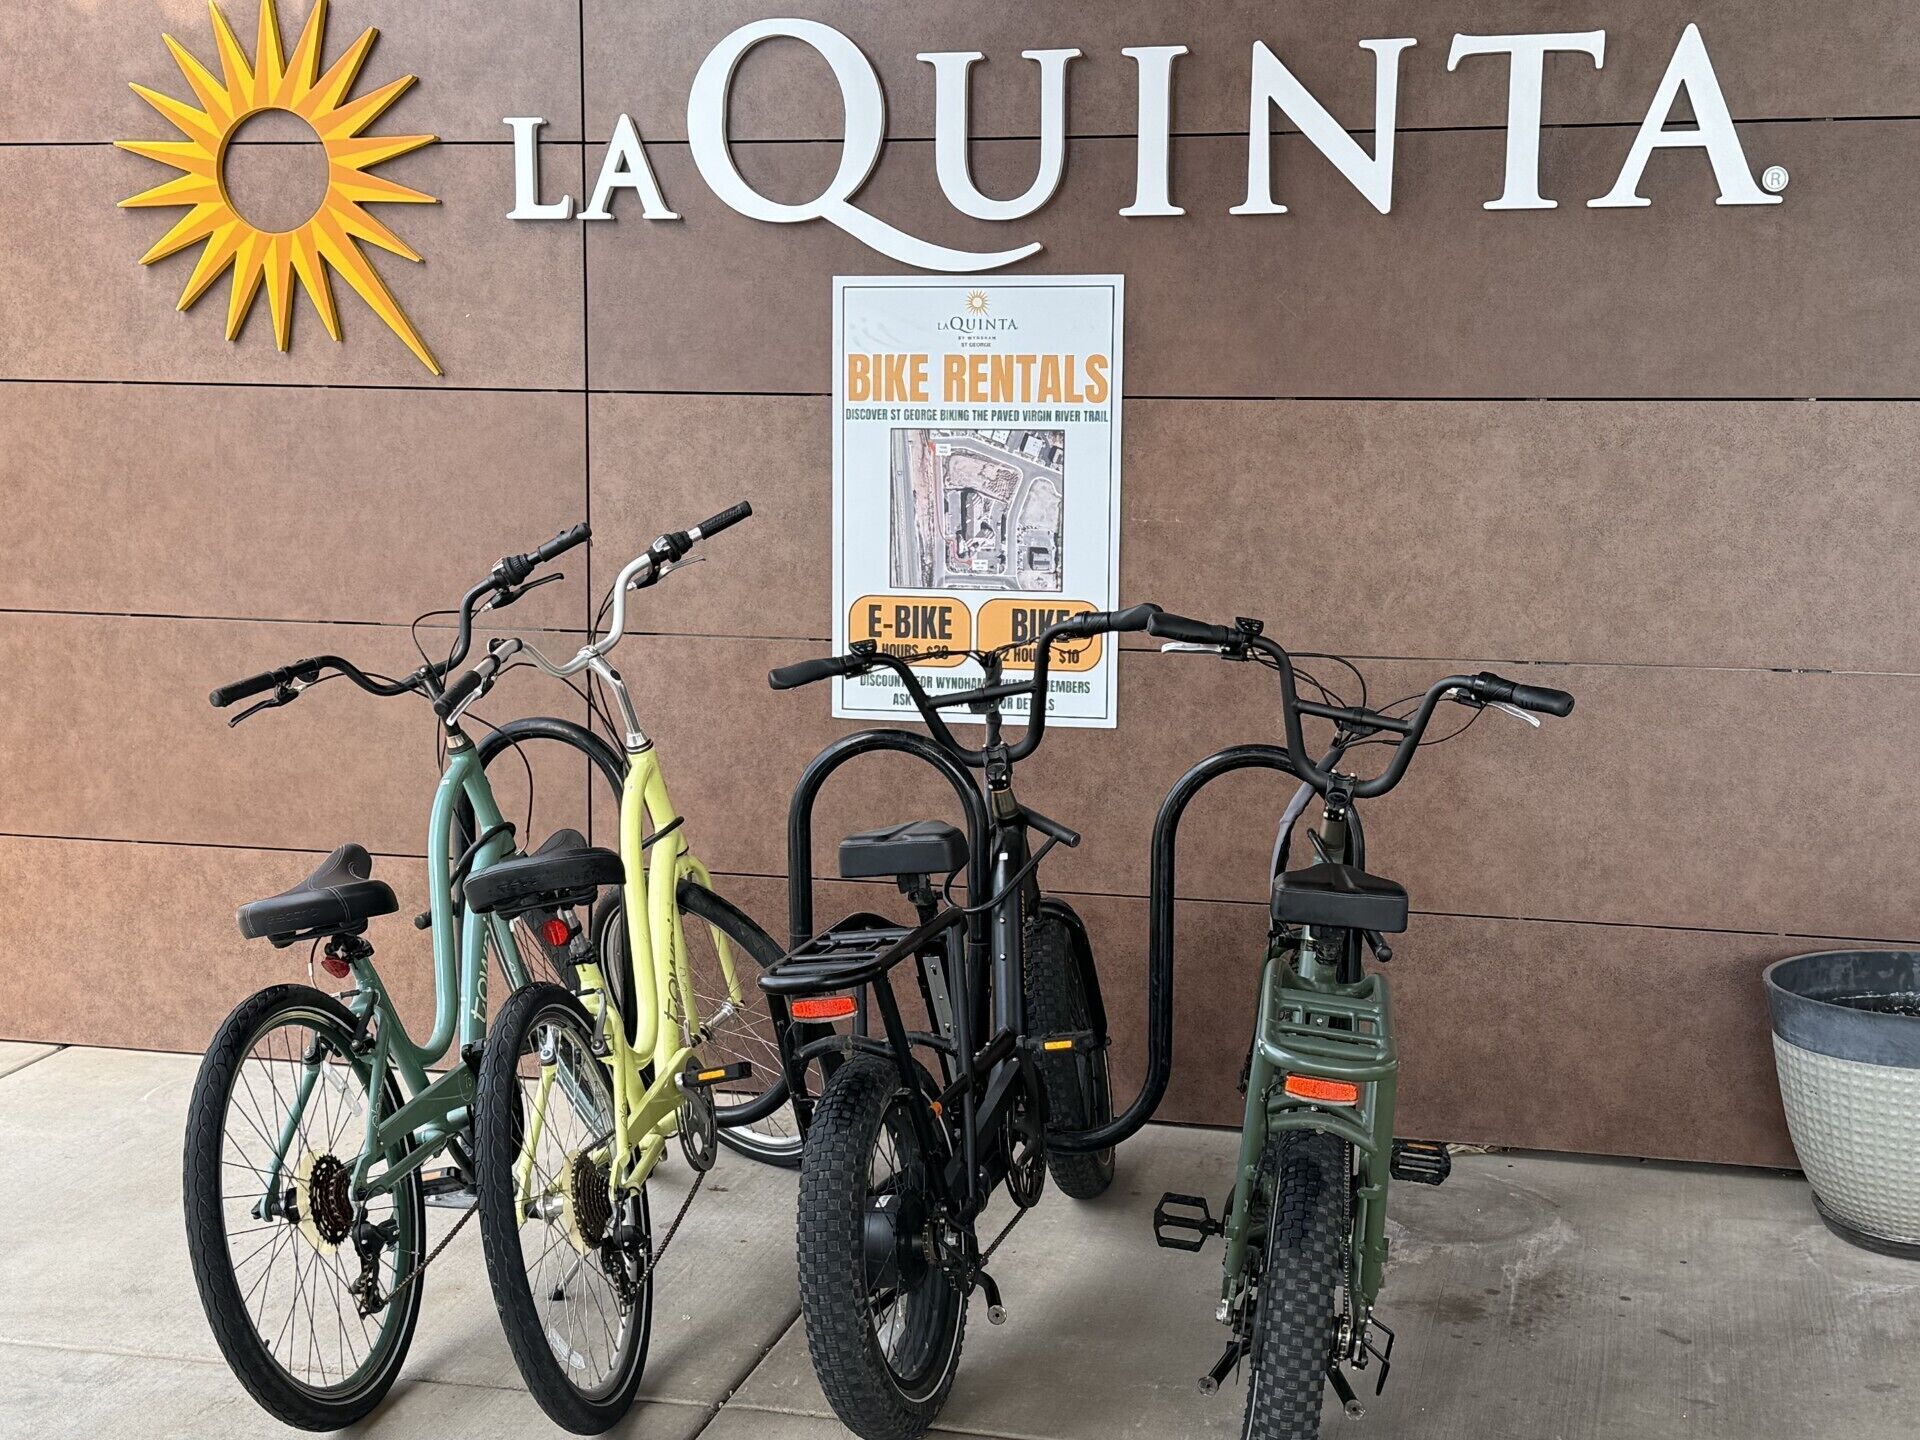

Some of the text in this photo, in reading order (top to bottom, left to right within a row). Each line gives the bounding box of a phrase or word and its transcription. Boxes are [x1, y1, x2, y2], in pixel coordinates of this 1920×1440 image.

[503, 114, 682, 221] LA
[687, 17, 1785, 273] QUINTA
[949, 316, 1019, 334] QUINTA
[848, 353, 1109, 404] BIKE RENTALS
[846, 408, 1109, 423] DISCOVER ST GEORGE BIKING THE PAVED VIRGIN RIVER TRAIL
[868, 604, 952, 640] E-BIKE
[881, 643, 919, 658] HOURS
[1013, 647, 1052, 663] HOU
[1058, 649, 1081, 664] $10
[860, 674, 908, 688] DISCOUN
[1047, 680, 1091, 694] EMBERS
[892, 693, 912, 706] ASK
